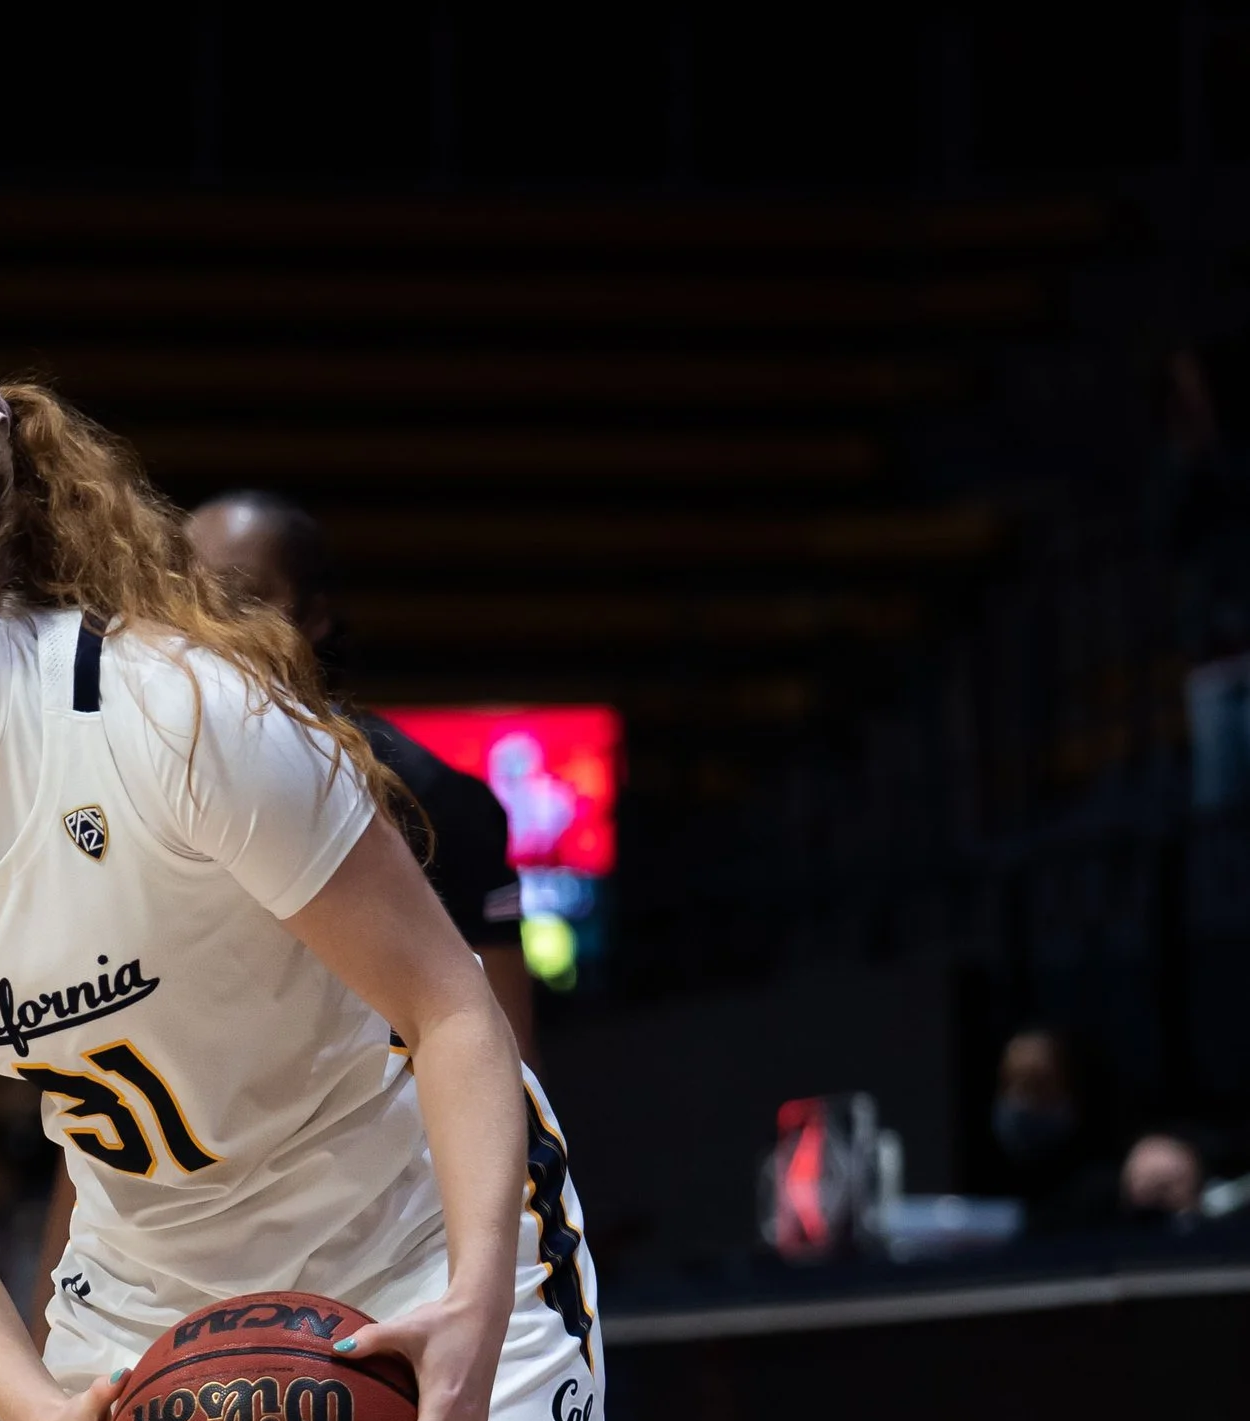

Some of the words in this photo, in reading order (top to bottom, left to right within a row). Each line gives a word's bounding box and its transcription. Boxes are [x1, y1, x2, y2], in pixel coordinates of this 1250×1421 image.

[65, 808, 105, 843] PAC
[80, 828, 104, 852] 12
[12, 1037, 225, 1179] 31
[173, 1302, 344, 1350] NCAA
